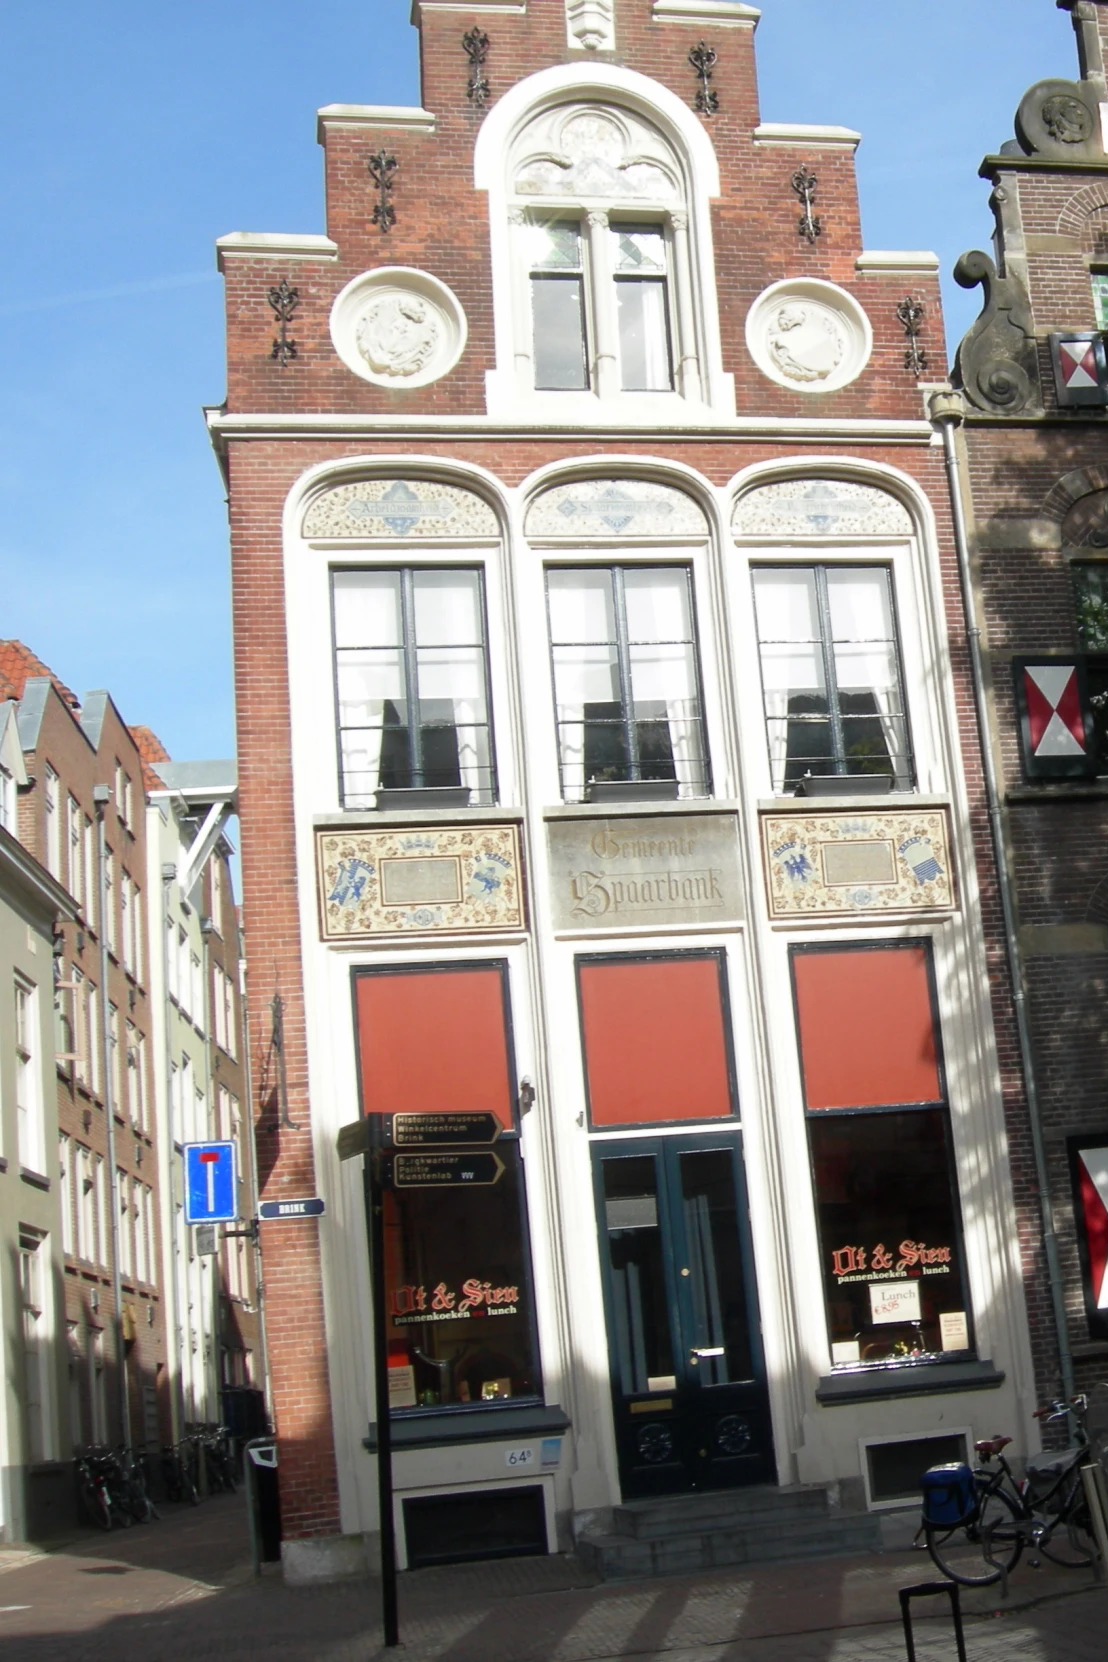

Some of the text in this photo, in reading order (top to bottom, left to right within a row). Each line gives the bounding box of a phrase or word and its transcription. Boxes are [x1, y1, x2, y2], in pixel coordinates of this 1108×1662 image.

[591, 829, 695, 859] Gemeente
[570, 867, 723, 918] Spaarbank
[397, 1115, 444, 1123] Historisch
[398, 1134, 424, 1142] Brink
[399, 1157, 459, 1165] Brgkwartier
[399, 1172, 452, 1180] Kunstenlab
[278, 1203, 306, 1214] BRINK
[832, 1240, 951, 1275] Ot & Sien
[838, 1270, 907, 1284] pannenkoeken
[922, 1265, 950, 1275] lunch
[431, 1282, 455, 1309] &
[458, 1279, 519, 1311] Sien
[881, 1290, 916, 1301] Lunch
[394, 1310, 470, 1325] pannenkoeken
[487, 1305, 517, 1315] lunch
